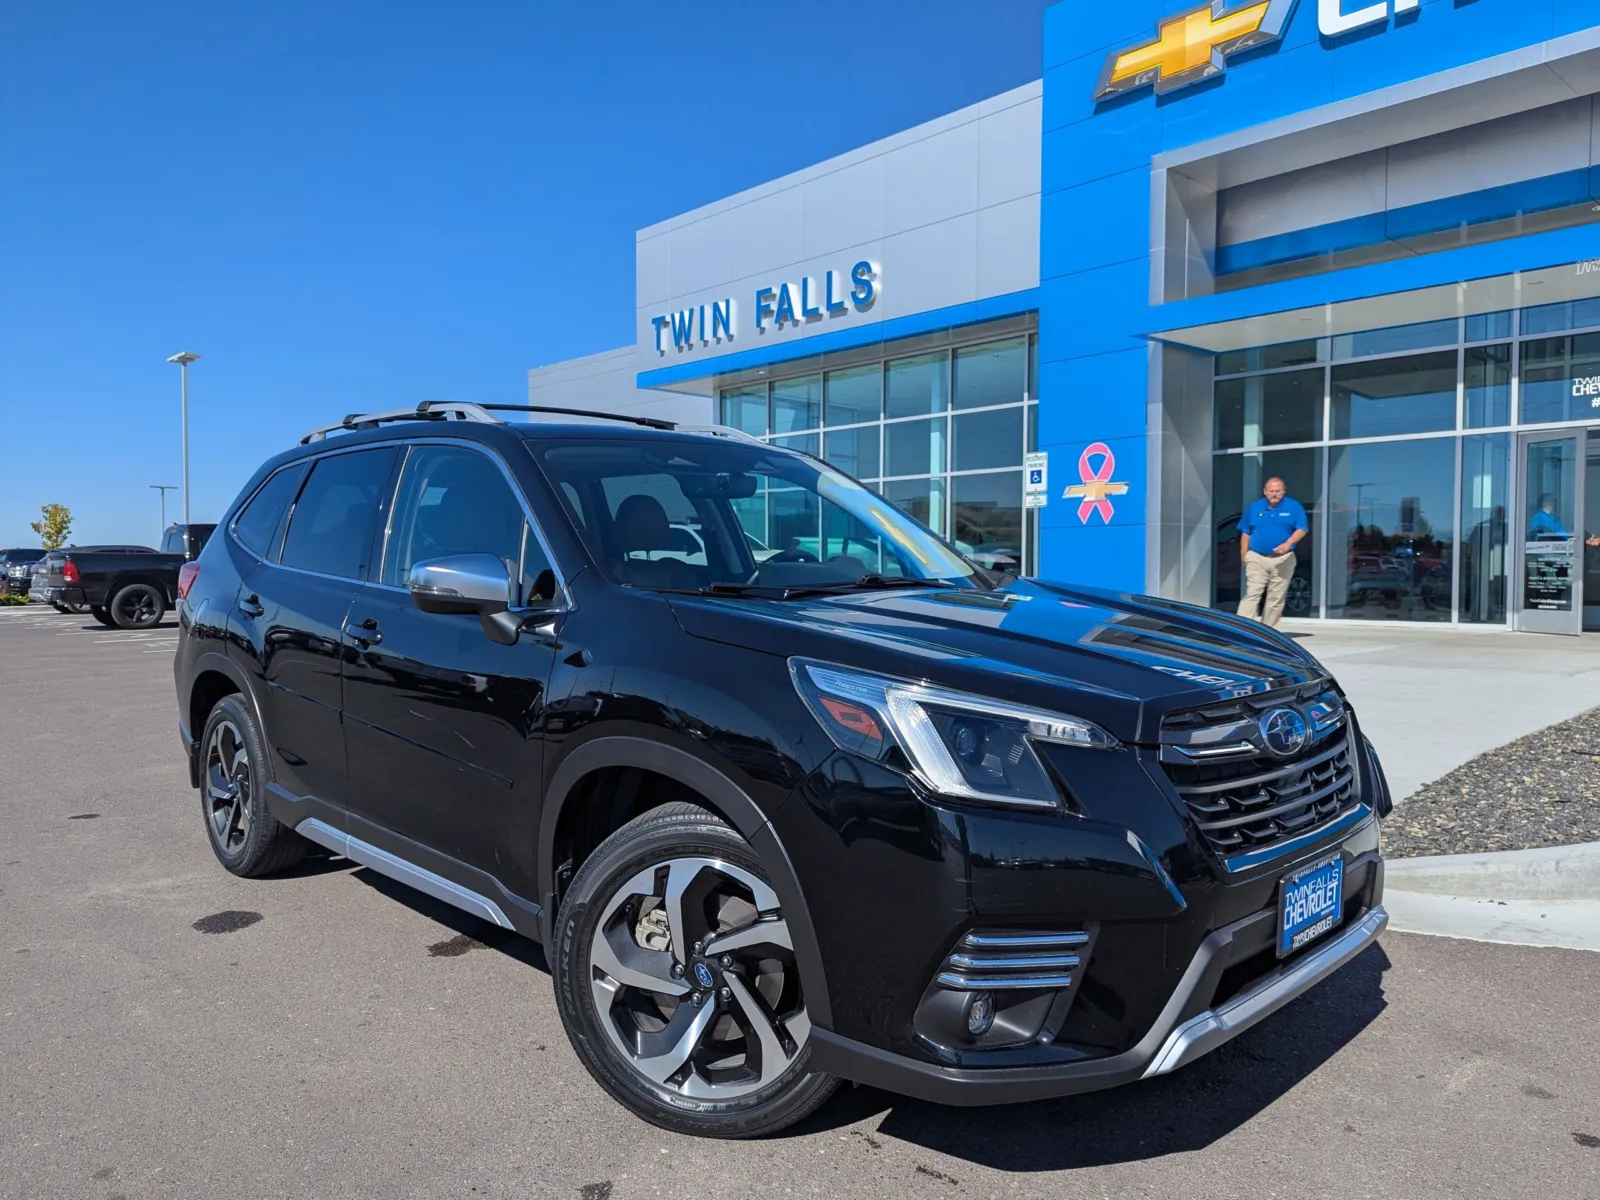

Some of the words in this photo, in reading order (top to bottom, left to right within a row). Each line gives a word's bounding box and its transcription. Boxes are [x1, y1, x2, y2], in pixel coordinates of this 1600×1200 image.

[651, 298, 734, 352] TWIN
[755, 261, 878, 330] FALLS
[1284, 881, 1338, 930] CHEVROLET
